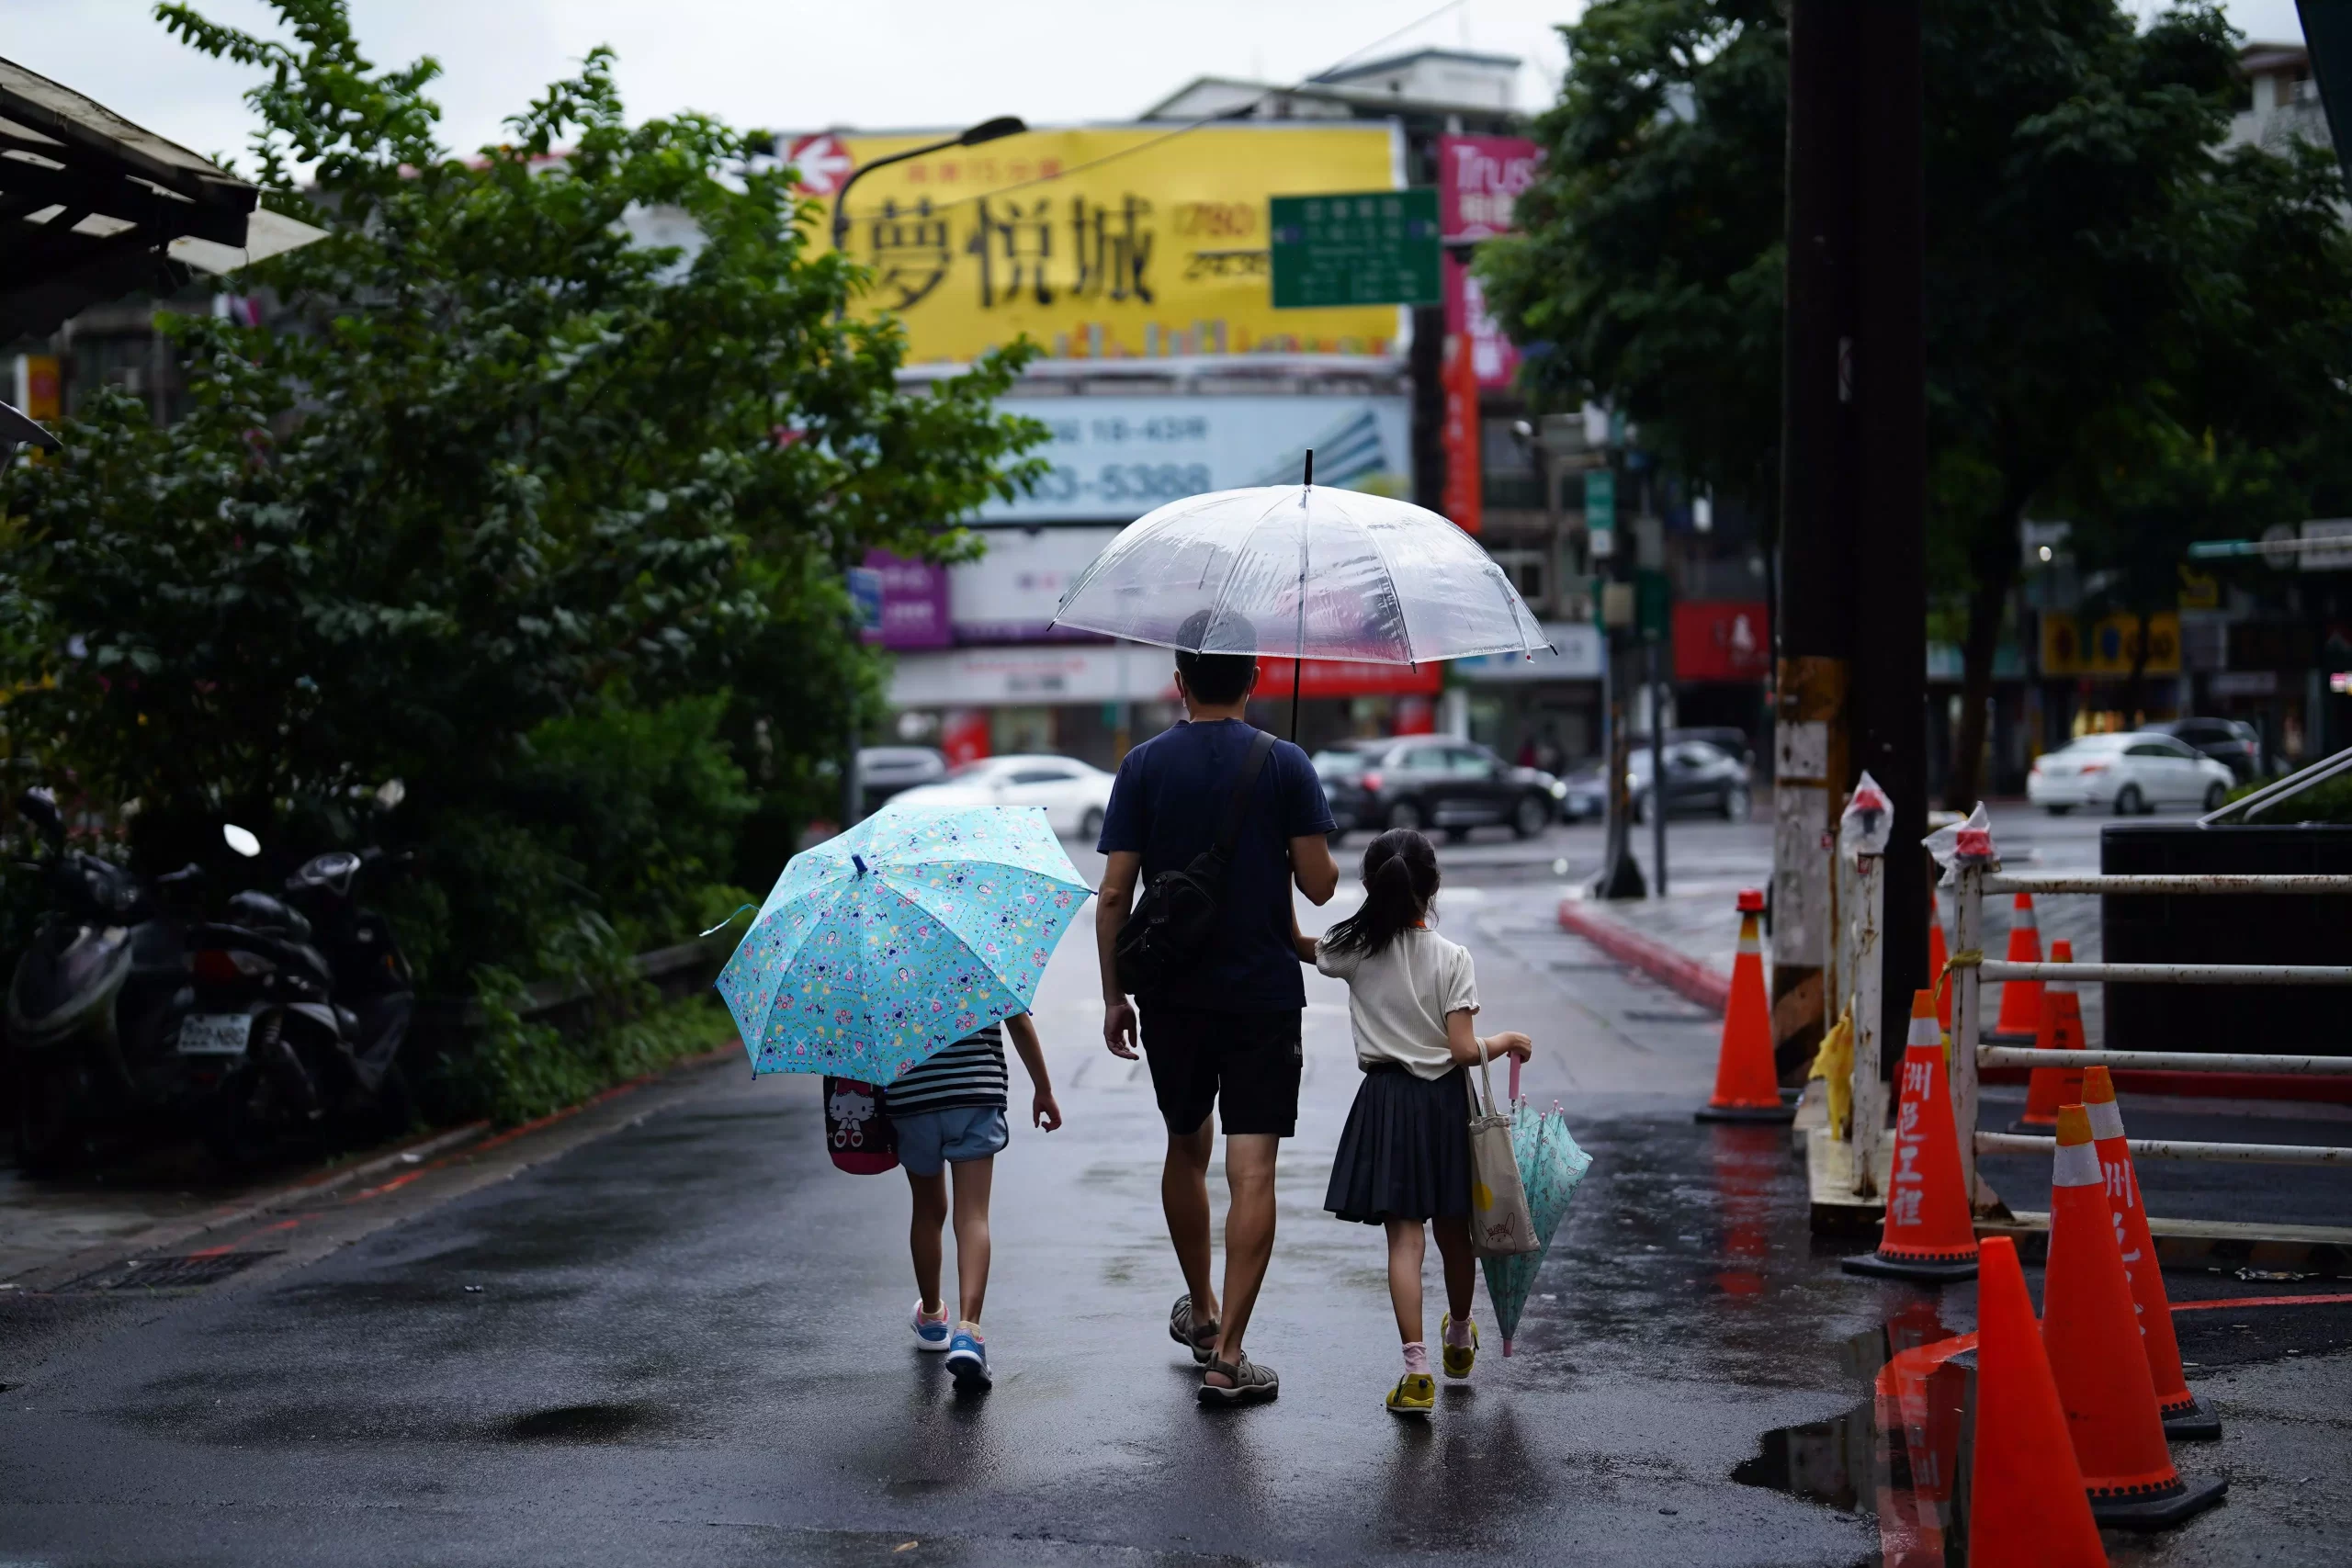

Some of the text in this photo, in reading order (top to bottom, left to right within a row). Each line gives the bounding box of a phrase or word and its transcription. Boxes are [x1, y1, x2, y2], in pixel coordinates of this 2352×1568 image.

[1452, 144, 1549, 195] Trus
[1892, 1061, 1933, 1226] 洲邑工程
